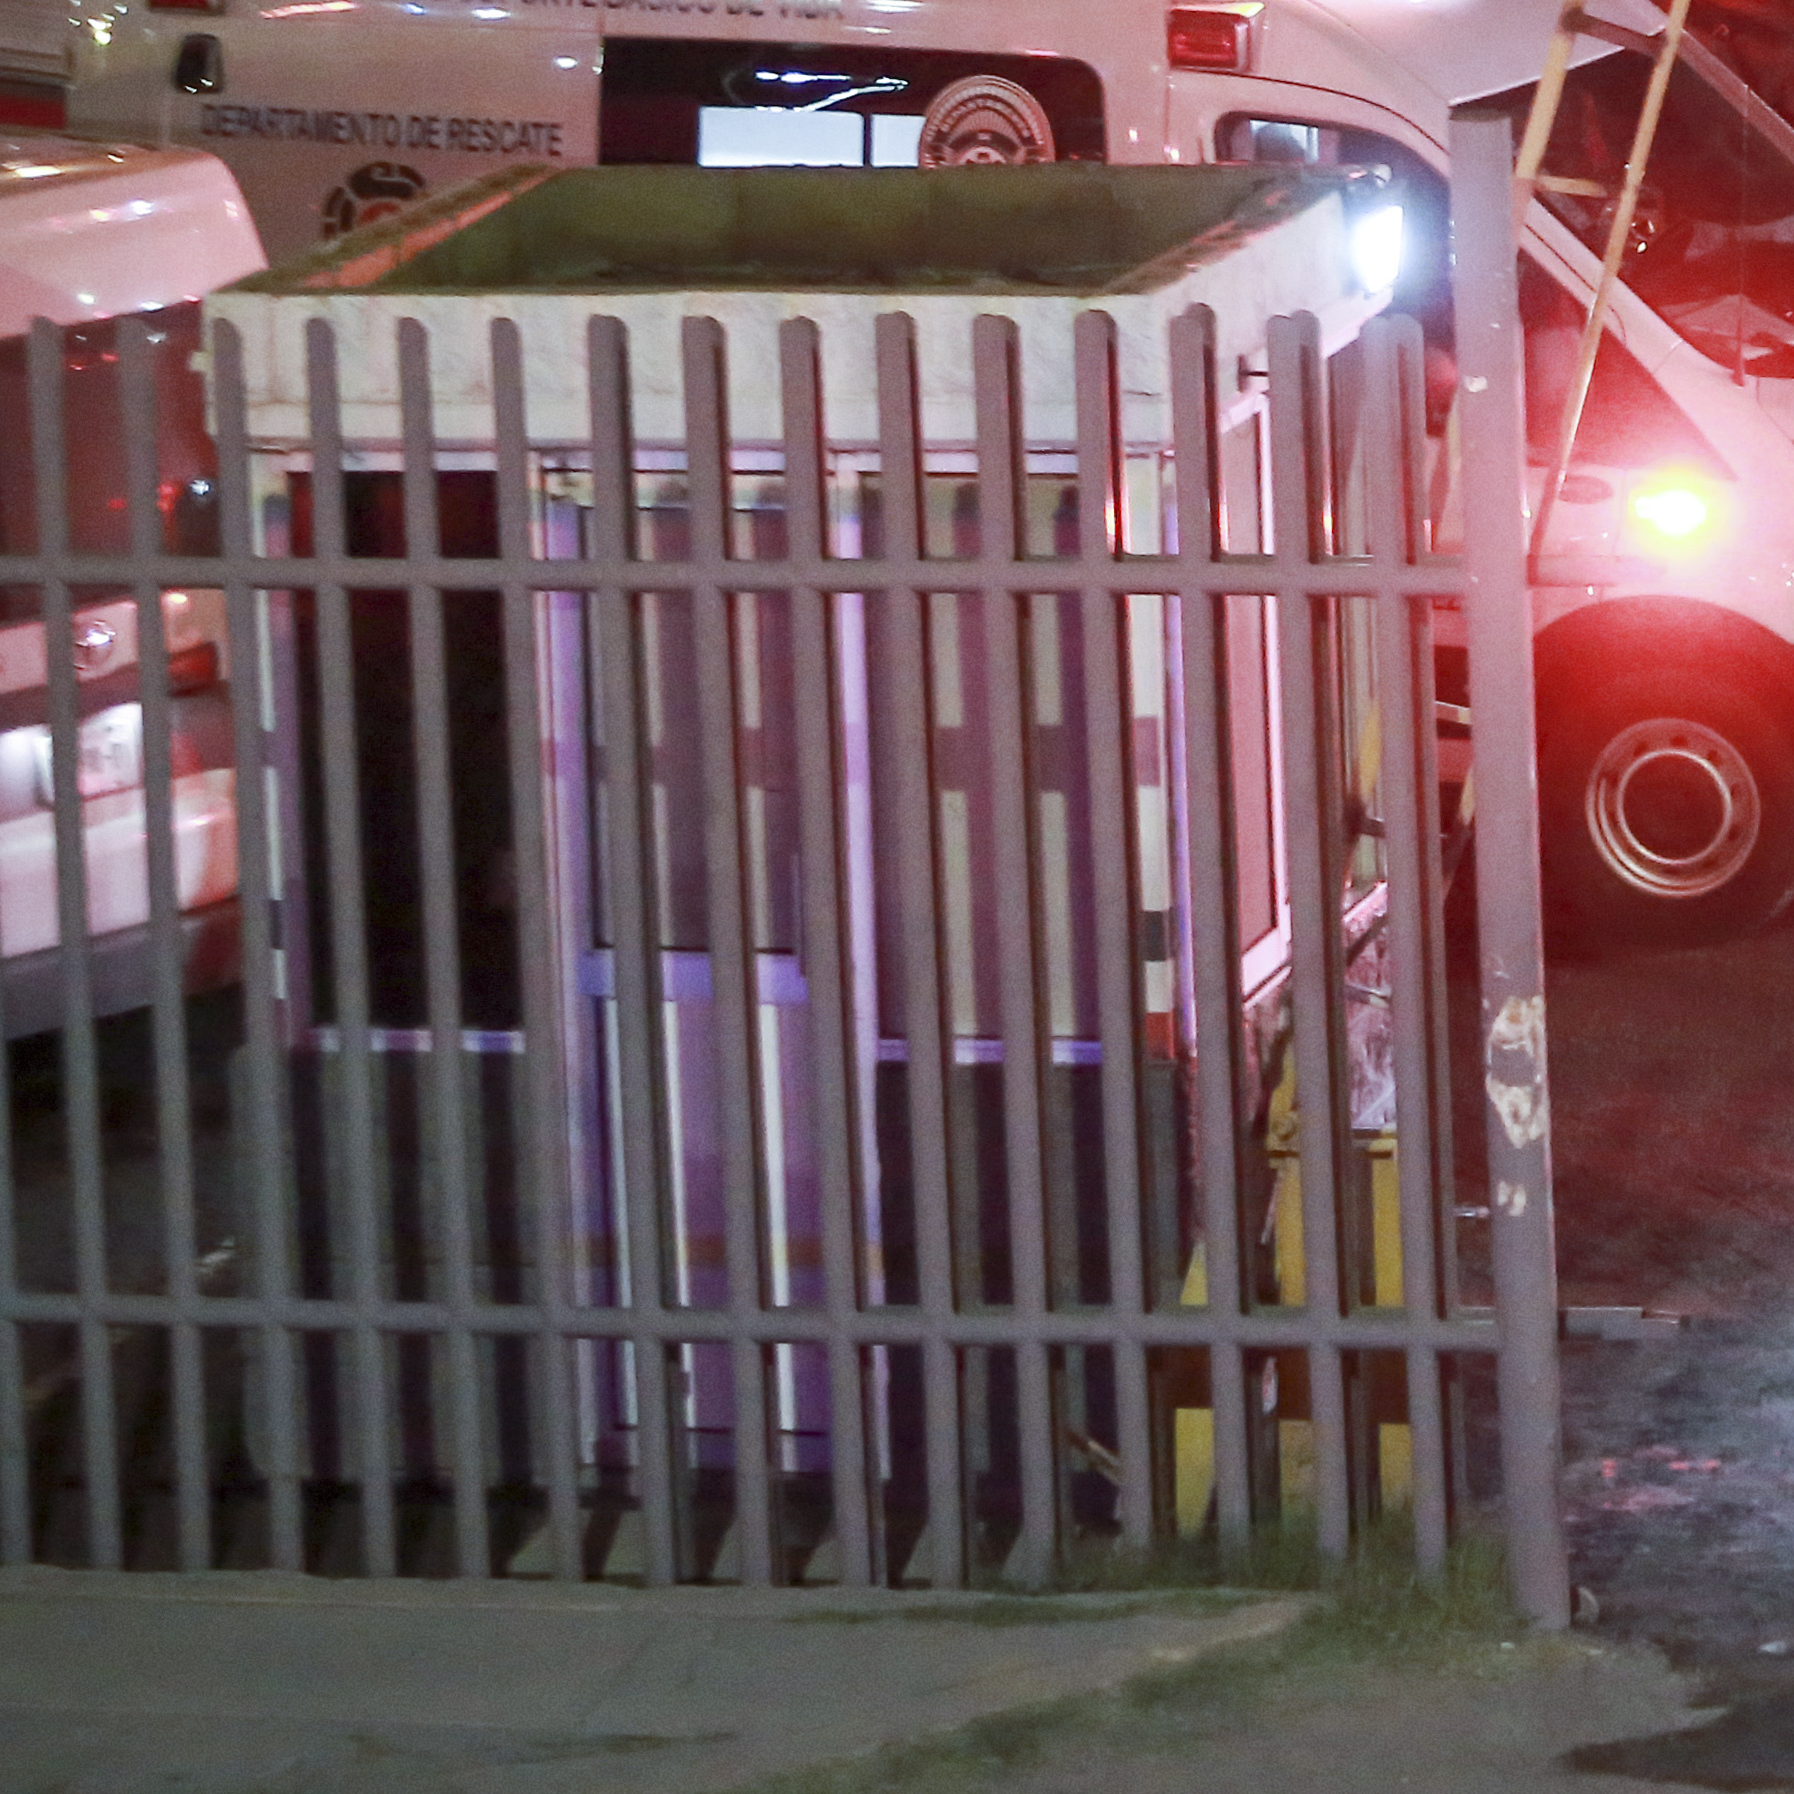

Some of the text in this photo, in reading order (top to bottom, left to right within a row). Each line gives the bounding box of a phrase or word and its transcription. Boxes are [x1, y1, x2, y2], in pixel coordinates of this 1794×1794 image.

[201, 104, 564, 156] DEPARTAMENTO DE RESCATE
